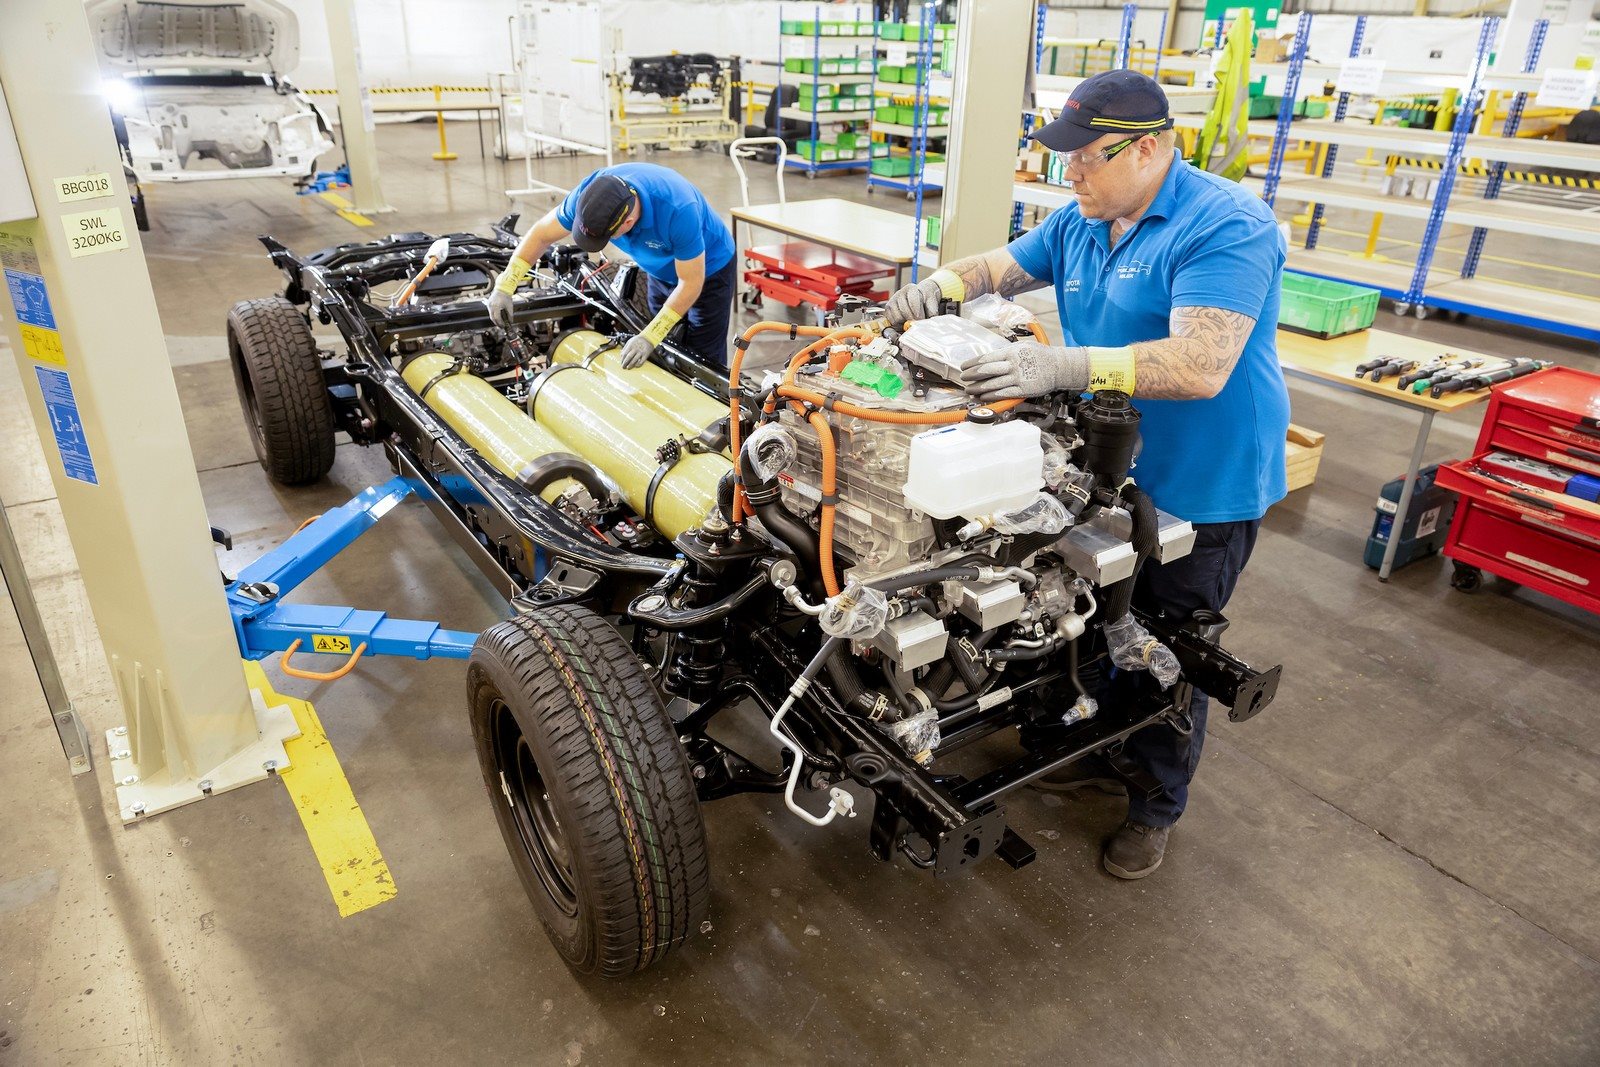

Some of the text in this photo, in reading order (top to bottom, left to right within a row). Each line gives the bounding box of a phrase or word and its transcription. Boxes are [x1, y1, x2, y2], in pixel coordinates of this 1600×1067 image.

[62, 179, 108, 195] BBG018
[80, 217, 106, 231] SWL
[72, 231, 121, 249] 3200KG
